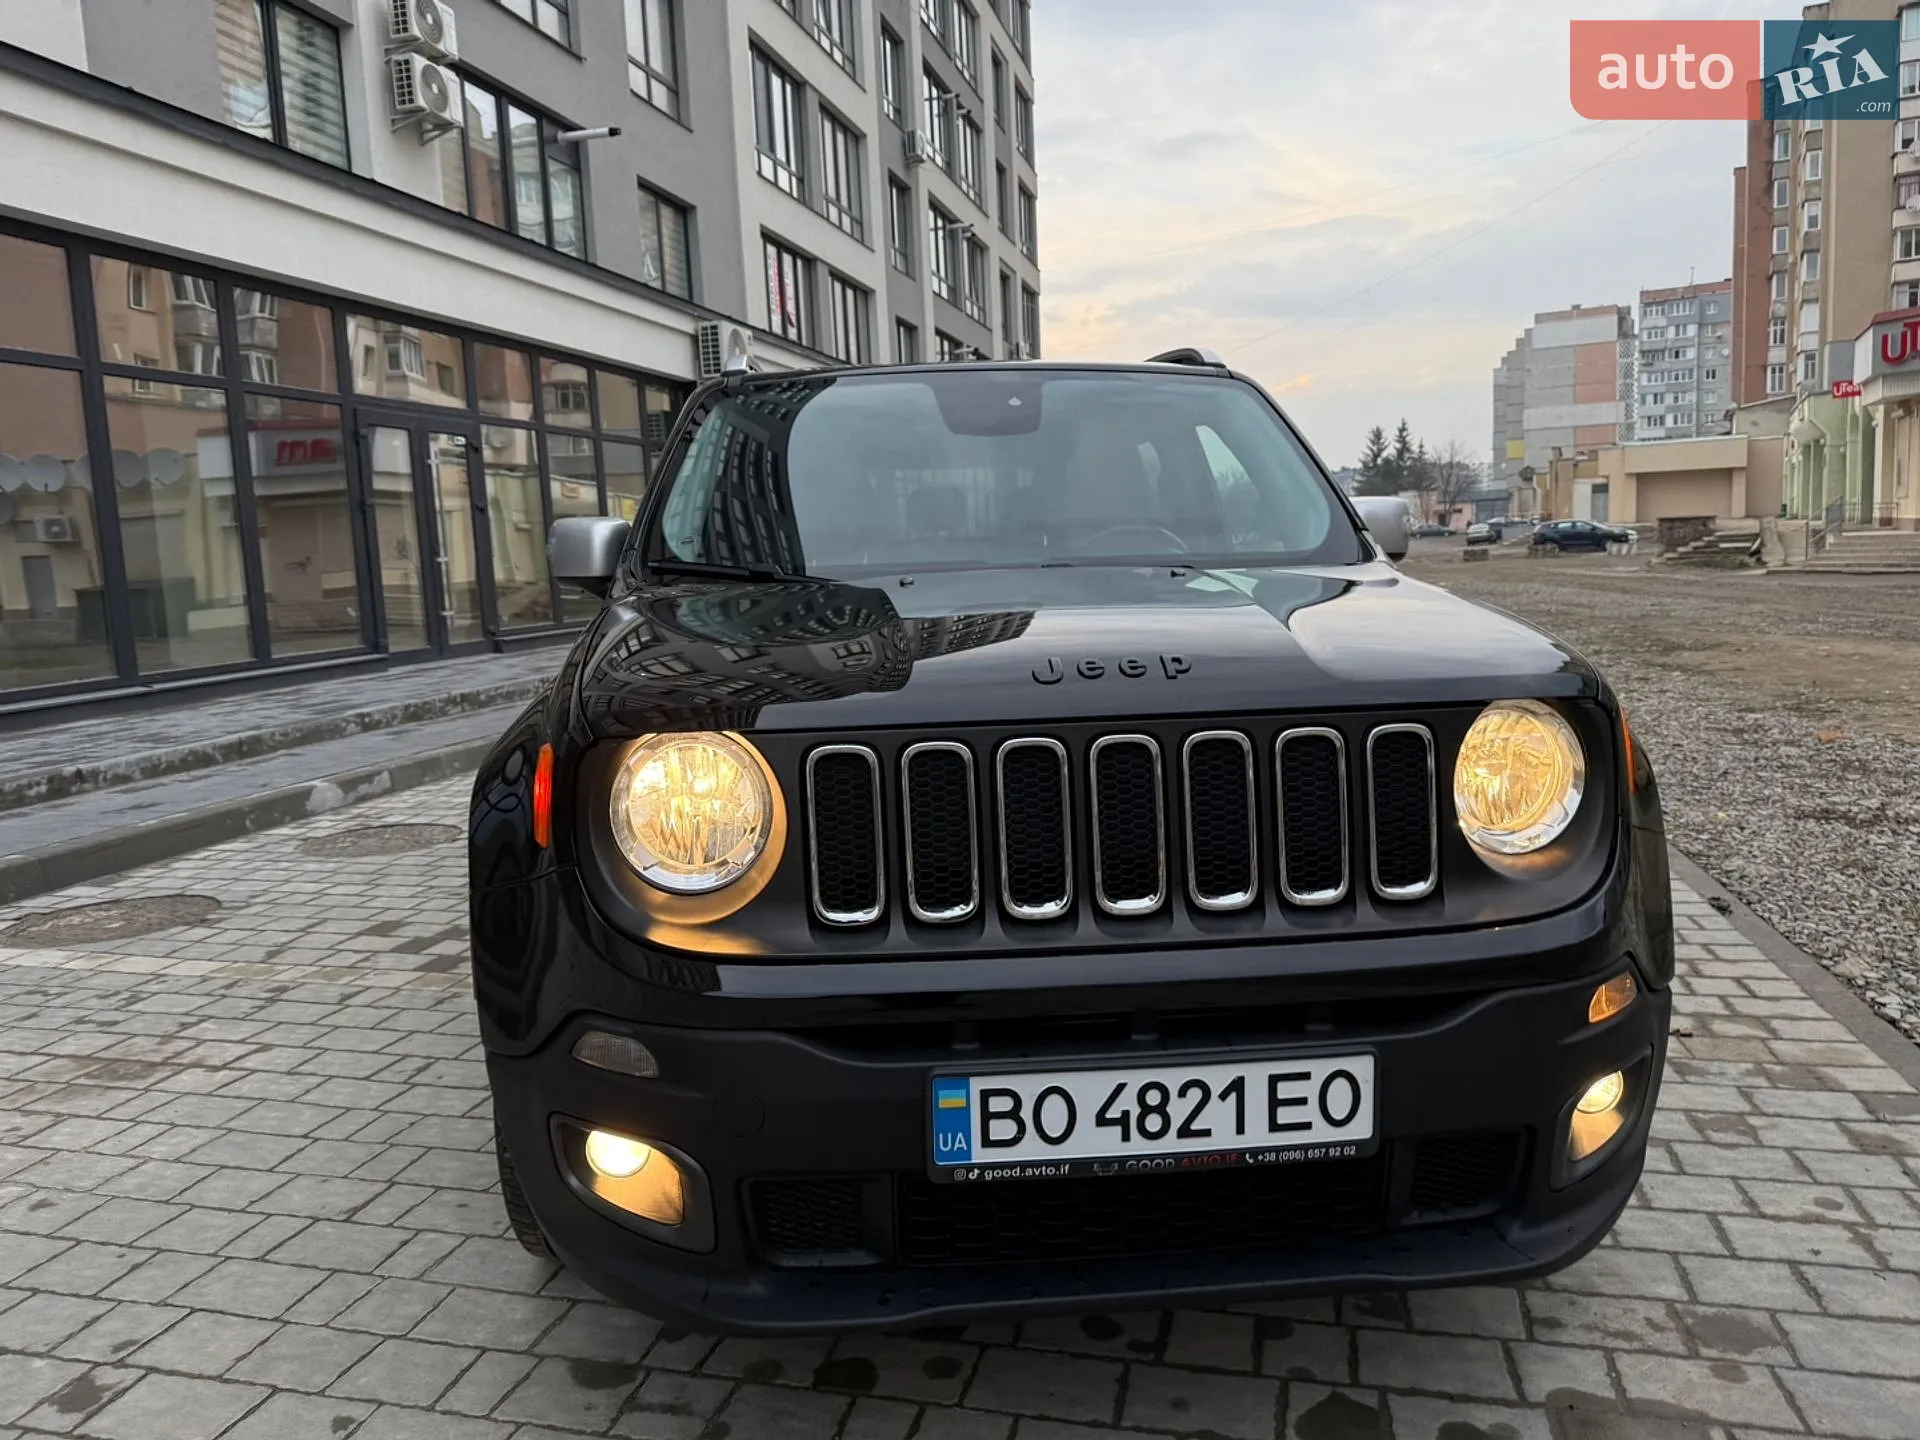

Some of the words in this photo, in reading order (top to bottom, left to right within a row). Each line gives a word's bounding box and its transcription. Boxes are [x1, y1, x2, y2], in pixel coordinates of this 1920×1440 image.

[1032, 654, 1192, 685] Jeep
[979, 1085, 1077, 1149] BO
[1095, 1076, 1246, 1143] 4821
[1267, 1069, 1362, 1133] EO
[939, 1131, 968, 1152] UA
[1257, 1151, 1277, 1163] +38
[1343, 1144, 1357, 1156] 02
[984, 1164, 1070, 1180] good.avto.if
